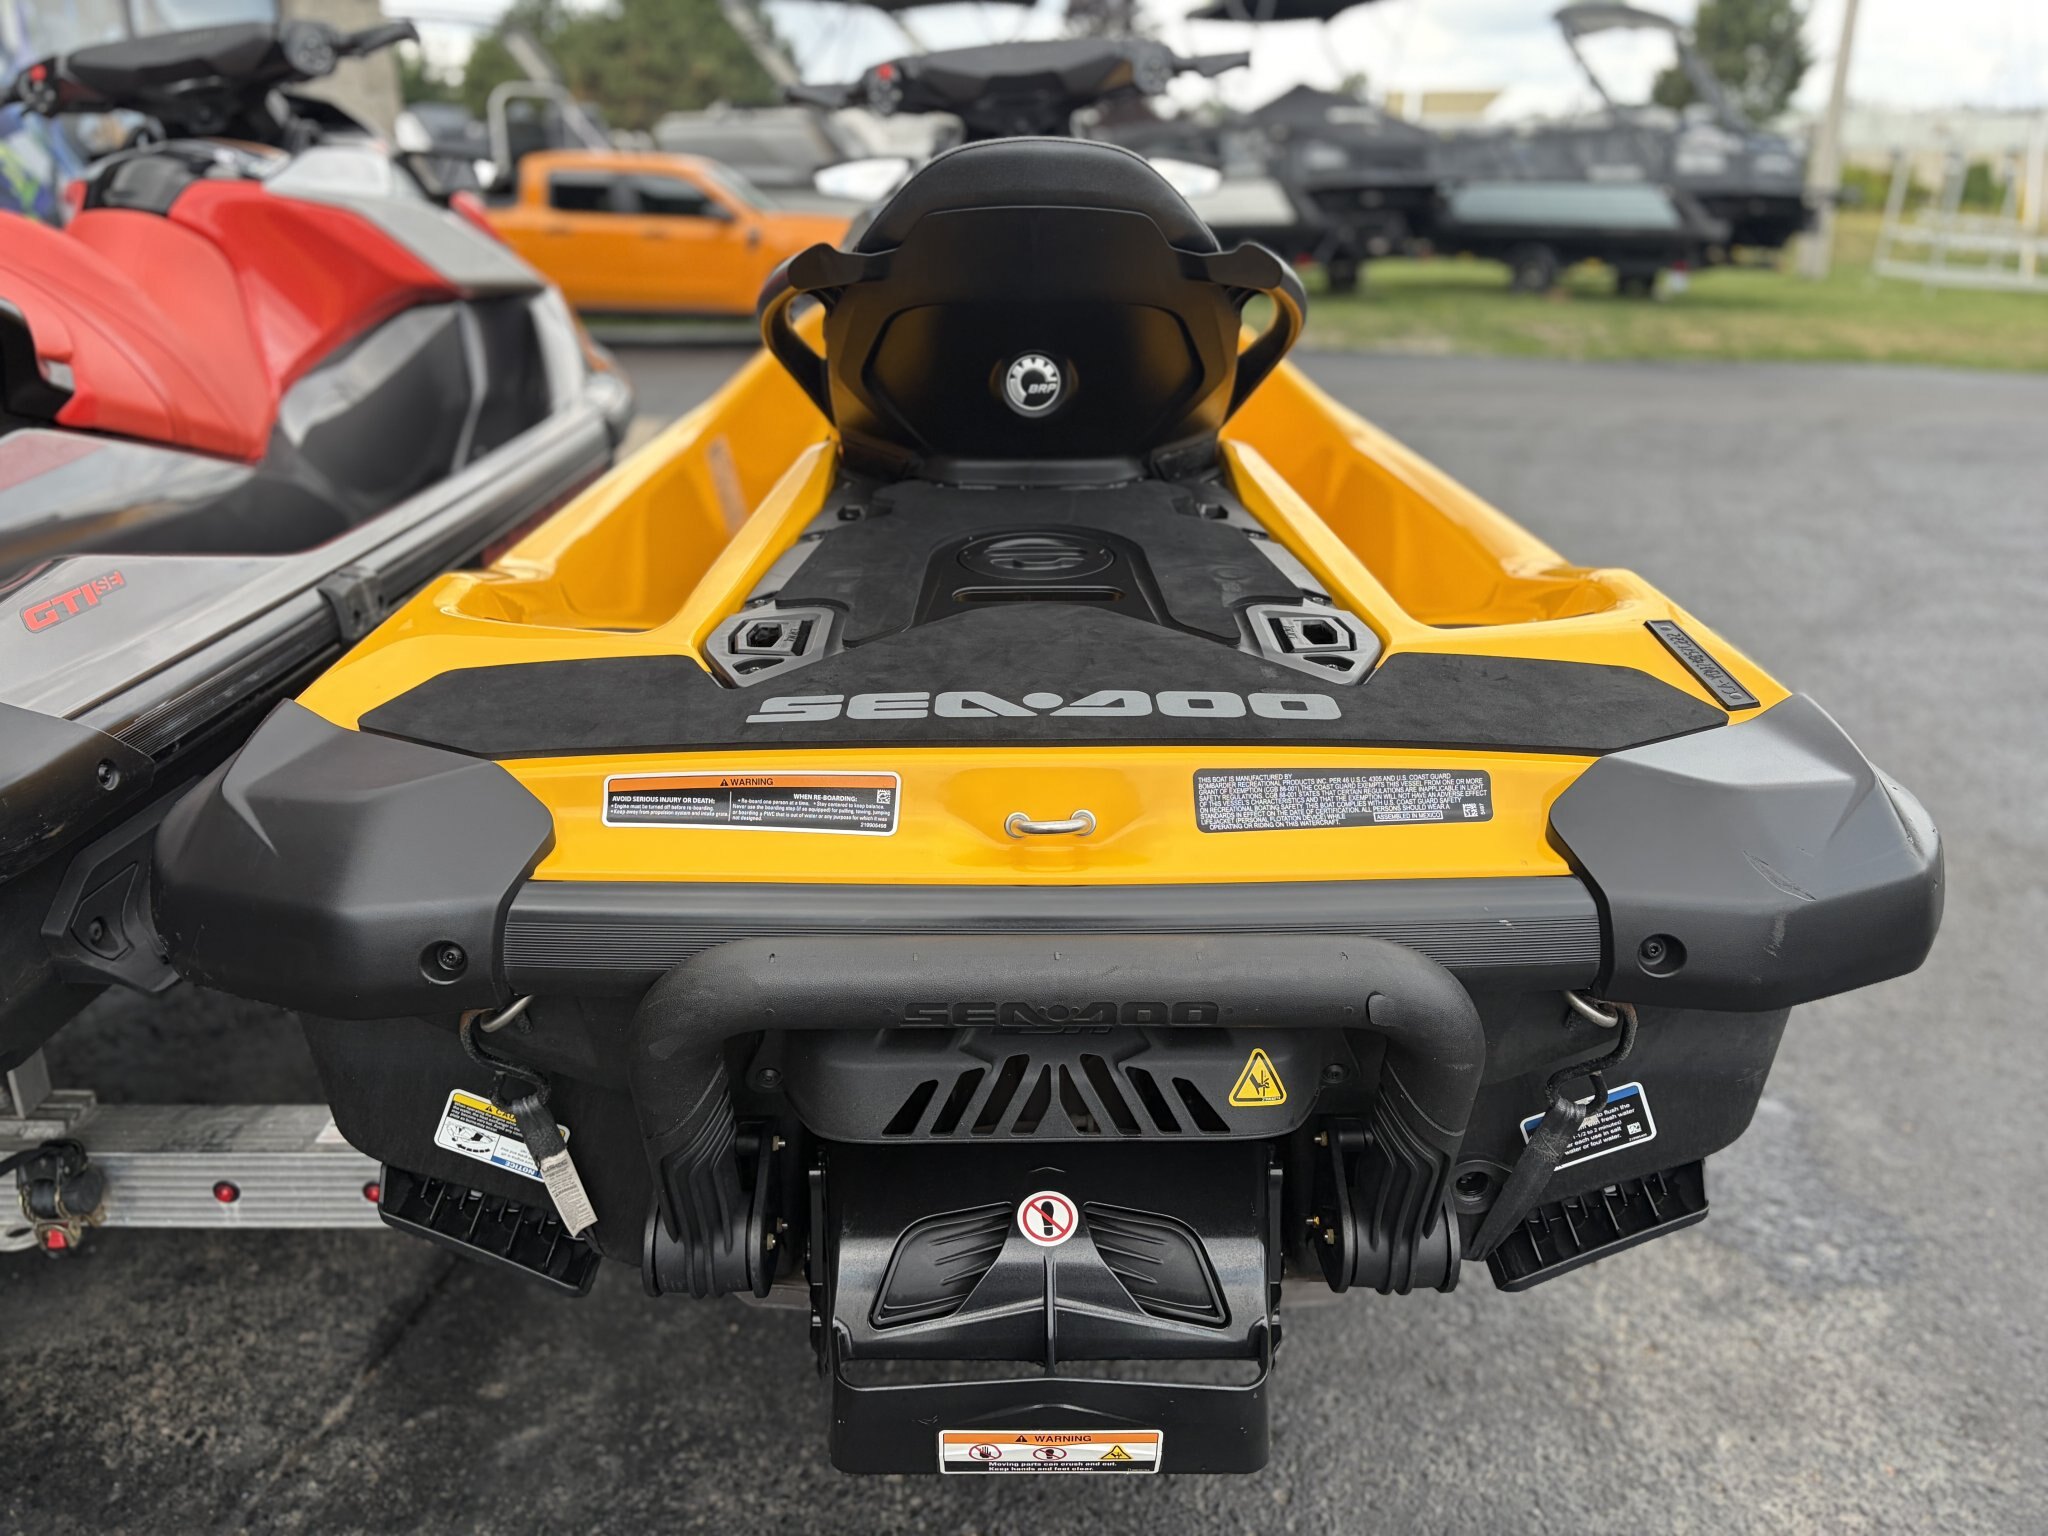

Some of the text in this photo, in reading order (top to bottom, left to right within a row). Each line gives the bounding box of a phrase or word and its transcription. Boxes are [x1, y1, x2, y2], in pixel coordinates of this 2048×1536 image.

[1028, 383, 1056, 394] BRP
[730, 778, 774, 786] WARNING
[1601, 1114, 1618, 1124] fresh
[1618, 1108, 1635, 1118] water
[1604, 1106, 1620, 1117] flush
[1620, 1102, 1631, 1111] the
[1574, 1136, 1590, 1146] each
[1590, 1134, 1602, 1142] use
[1610, 1126, 1622, 1135] salt
[1564, 1146, 1582, 1156] water
[1590, 1139, 1602, 1148] foul
[1602, 1134, 1622, 1144] water.
[504, 1160, 535, 1175] NOTICE
